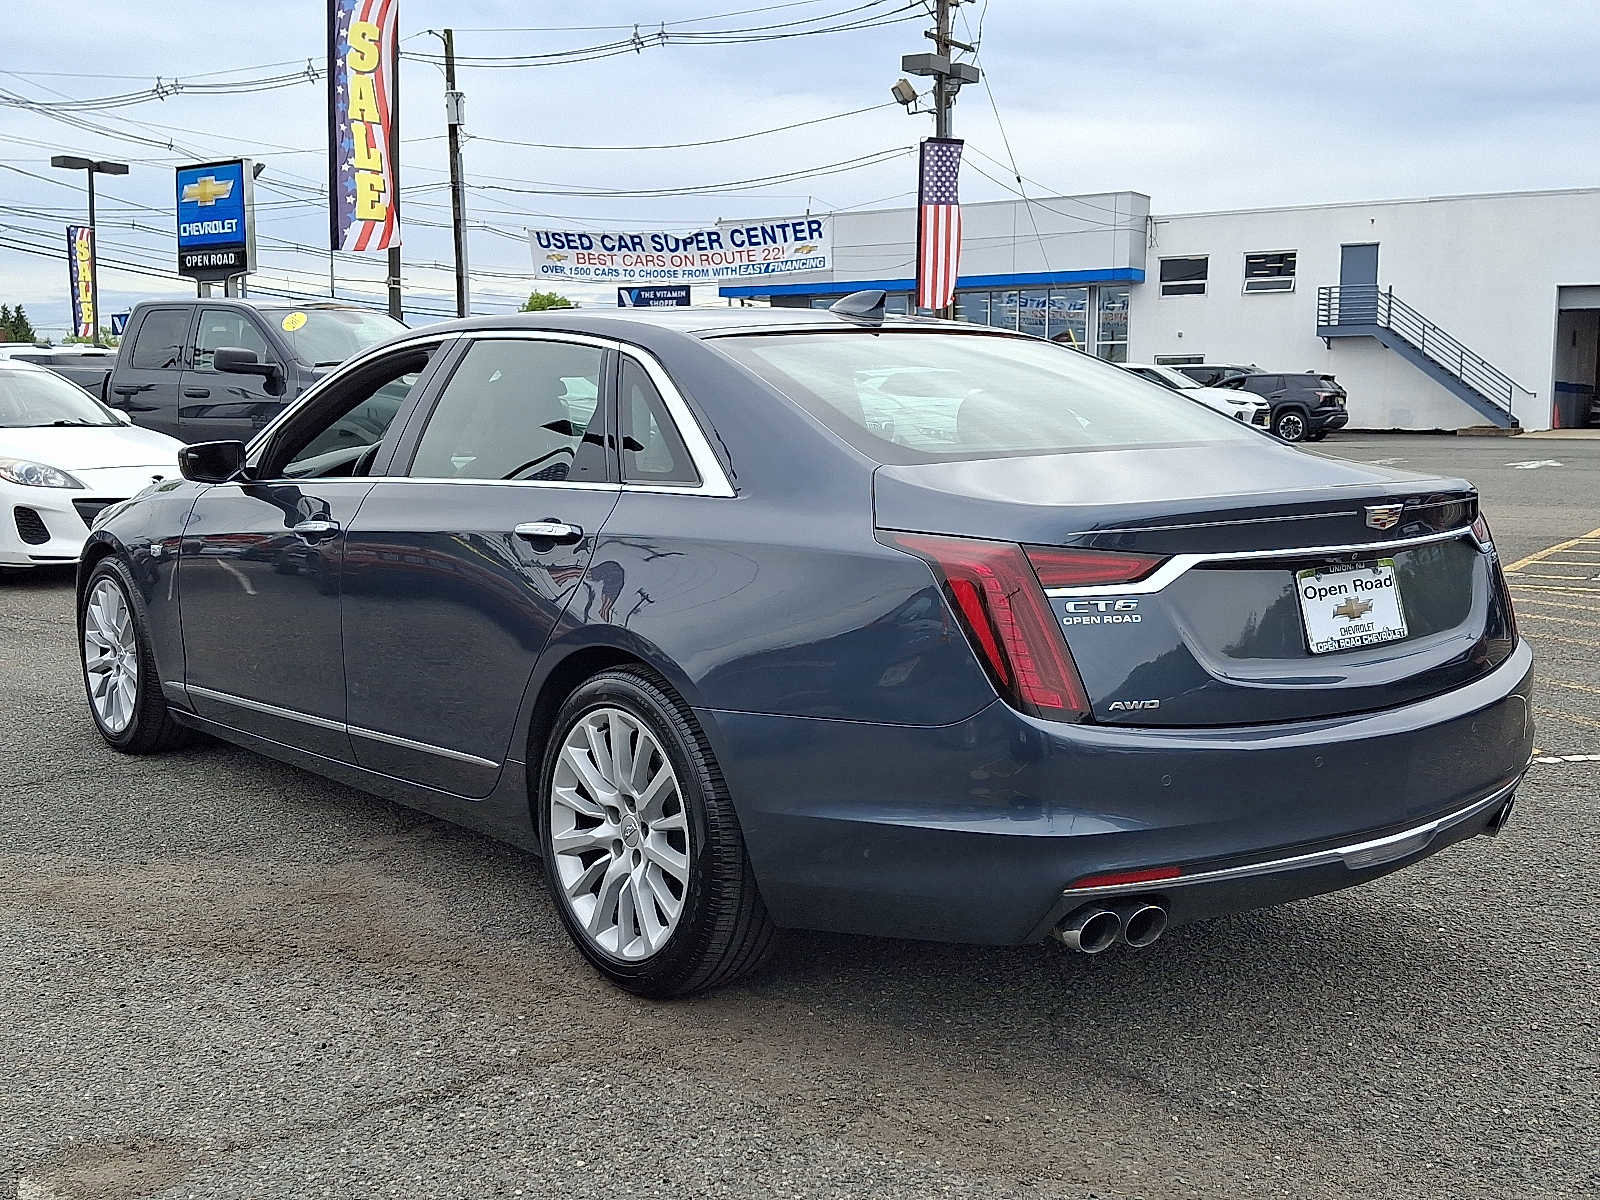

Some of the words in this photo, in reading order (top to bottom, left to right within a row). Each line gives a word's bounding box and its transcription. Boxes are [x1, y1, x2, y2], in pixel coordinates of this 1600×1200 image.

[347, 20, 387, 222] SALE
[180, 219, 238, 237] CHEVROLET
[535, 231, 594, 251] USED
[600, 234, 646, 252] CAR
[650, 231, 724, 253] SUPER
[729, 219, 823, 248] CENTER
[186, 254, 209, 267] OPEN
[210, 253, 235, 265] ROAD
[575, 252, 617, 266] BEST
[622, 254, 666, 267] CARS
[670, 254, 695, 268] ON
[700, 249, 756, 266] ROUTE
[761, 246, 785, 261] 22!
[541, 265, 566, 274] OVER
[569, 267, 591, 276] 1500
[594, 268, 620, 277] CARS
[623, 269, 636, 278] TO
[639, 269, 679, 279] CHOOSE
[682, 269, 709, 279] FROM
[712, 266, 738, 278] WITH
[740, 264, 767, 275] EASY
[768, 257, 825, 272] FINANCING
[76, 239, 93, 323] SALE
[640, 291, 655, 299] THE
[656, 290, 686, 298] VITAMIN
[1303, 584, 1348, 601] Open
[1353, 575, 1393, 593] Road
[1065, 599, 1139, 613] CT6
[1062, 616, 1101, 625] OPEN
[1103, 614, 1142, 624] ROAD
[1340, 622, 1375, 636] CHEVROLET
[1317, 640, 1338, 652] OPEN
[1339, 636, 1361, 649] ROAD
[1362, 628, 1406, 644] CHEVROLET
[1108, 699, 1160, 711] AWD
